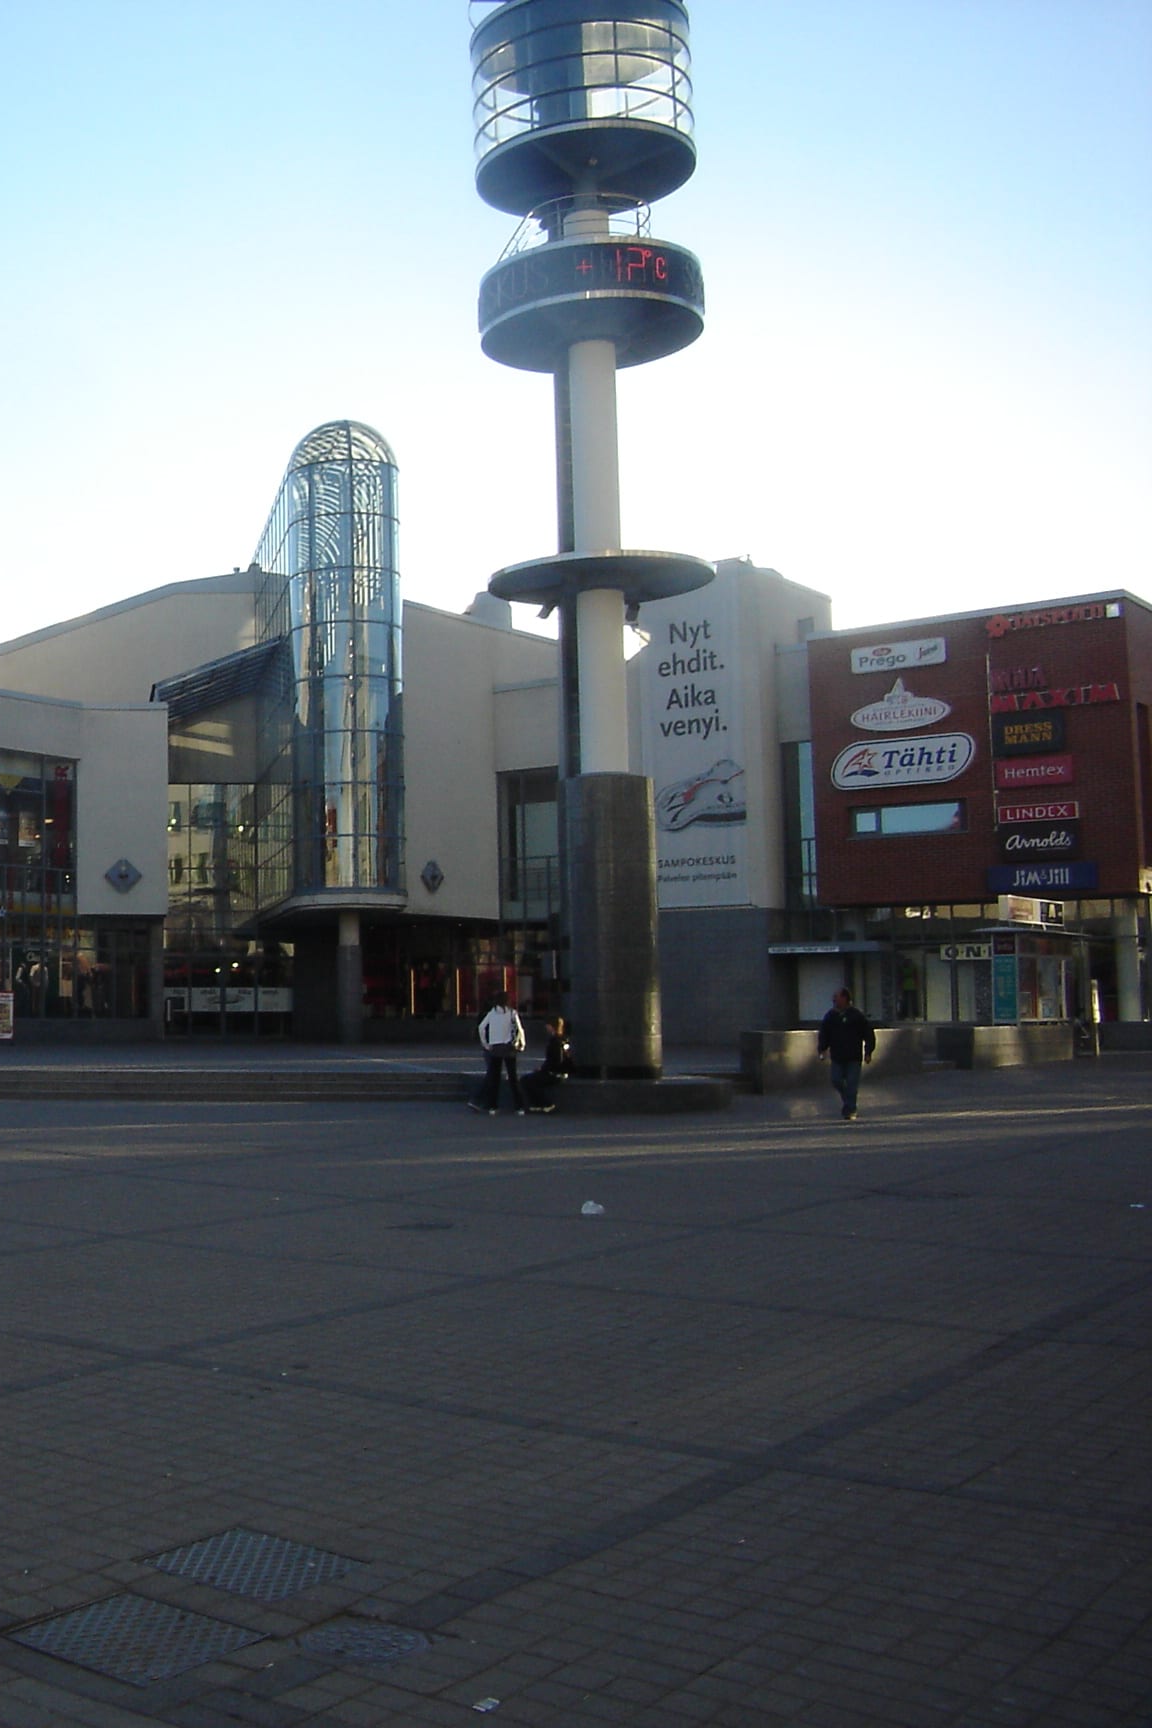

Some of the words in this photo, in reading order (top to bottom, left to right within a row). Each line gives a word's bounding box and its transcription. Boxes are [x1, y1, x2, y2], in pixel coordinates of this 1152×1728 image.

[669, 619, 711, 649] Nyt
[658, 649, 725, 677] ehdit.
[858, 654, 906, 668] Prego
[666, 684, 716, 710] Aika
[990, 683, 1119, 714] MAXIM
[660, 710, 728, 740] venyi.
[1004, 721, 1053, 735] DRESS
[1004, 731, 1053, 745] MANN
[882, 743, 958, 769] Tähti
[1004, 765, 1065, 780] Hemtex
[1006, 805, 1068, 820] LINDEX
[1005, 830, 1072, 851] Arnolds
[657, 854, 737, 869] SAMPOKESKUS
